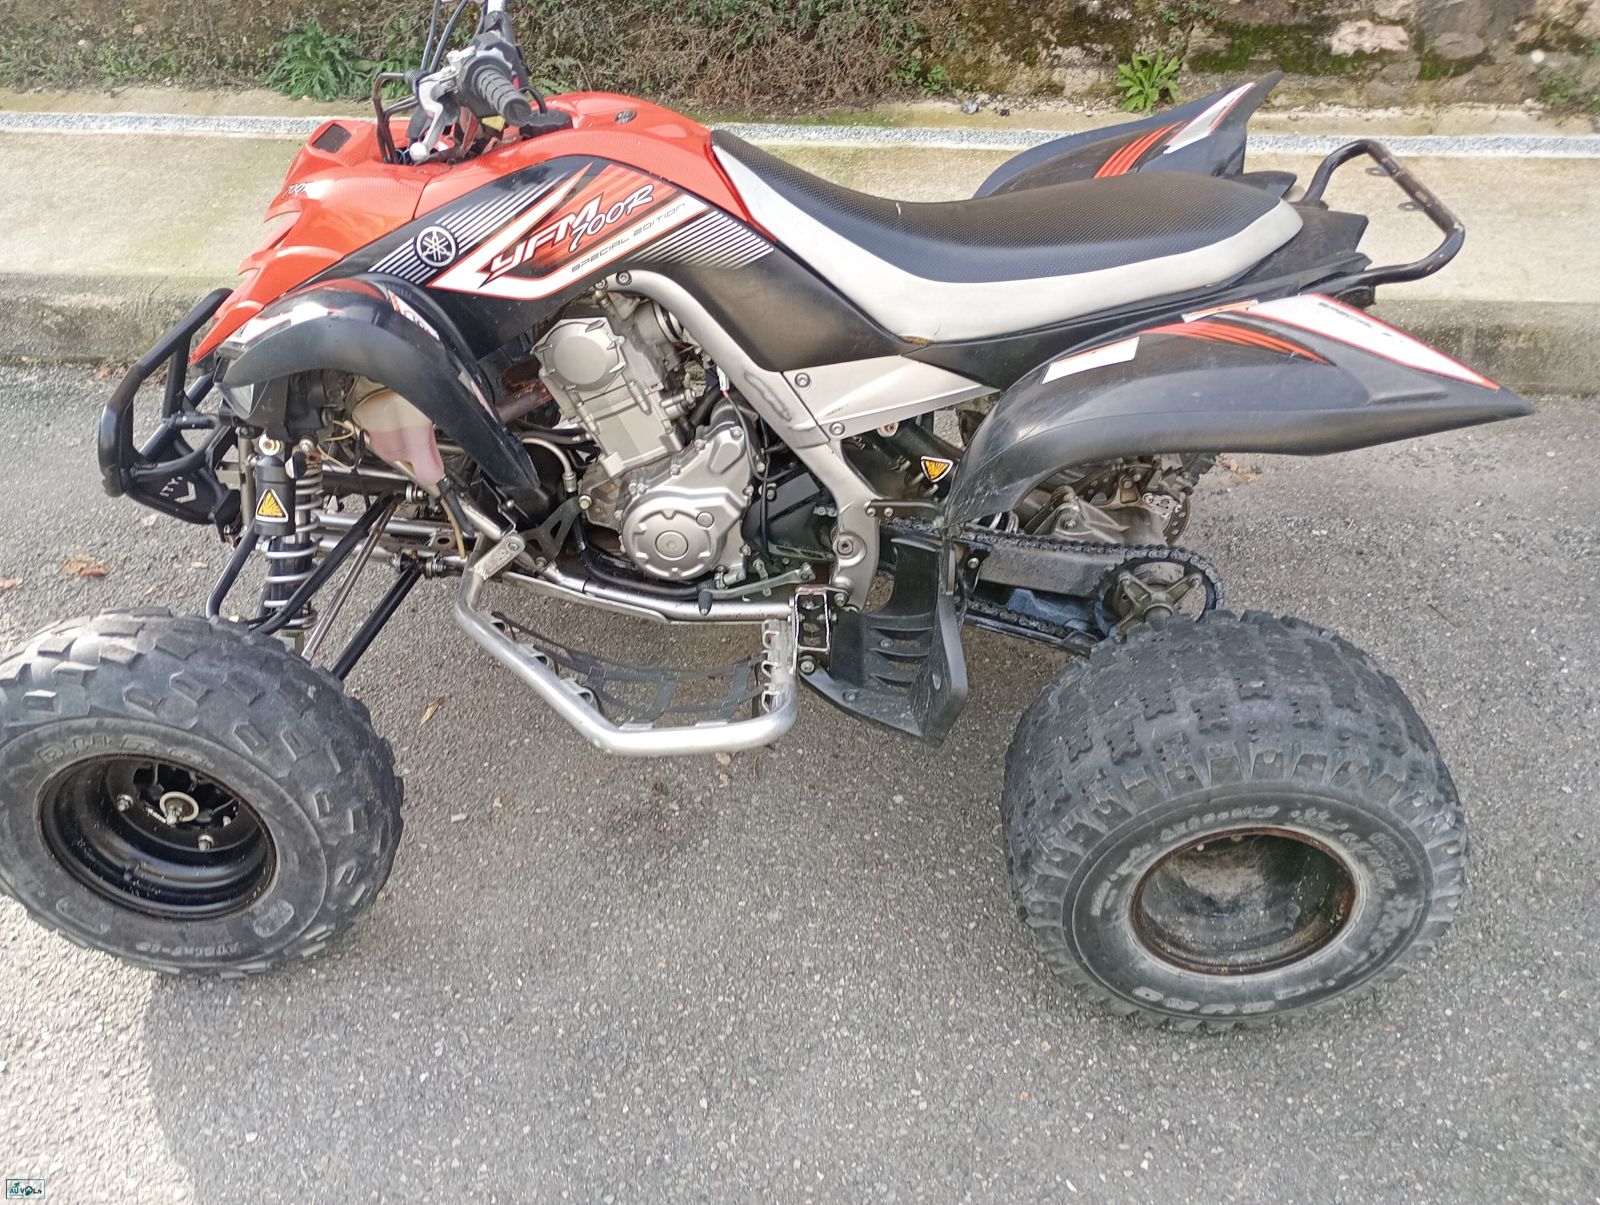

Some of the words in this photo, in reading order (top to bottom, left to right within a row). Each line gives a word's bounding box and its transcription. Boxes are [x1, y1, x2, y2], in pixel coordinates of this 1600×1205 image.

[482, 190, 605, 286] YFM
[569, 184, 654, 253] 700R
[571, 236, 630, 273] SPECIAL
[633, 203, 686, 237] EDITION
